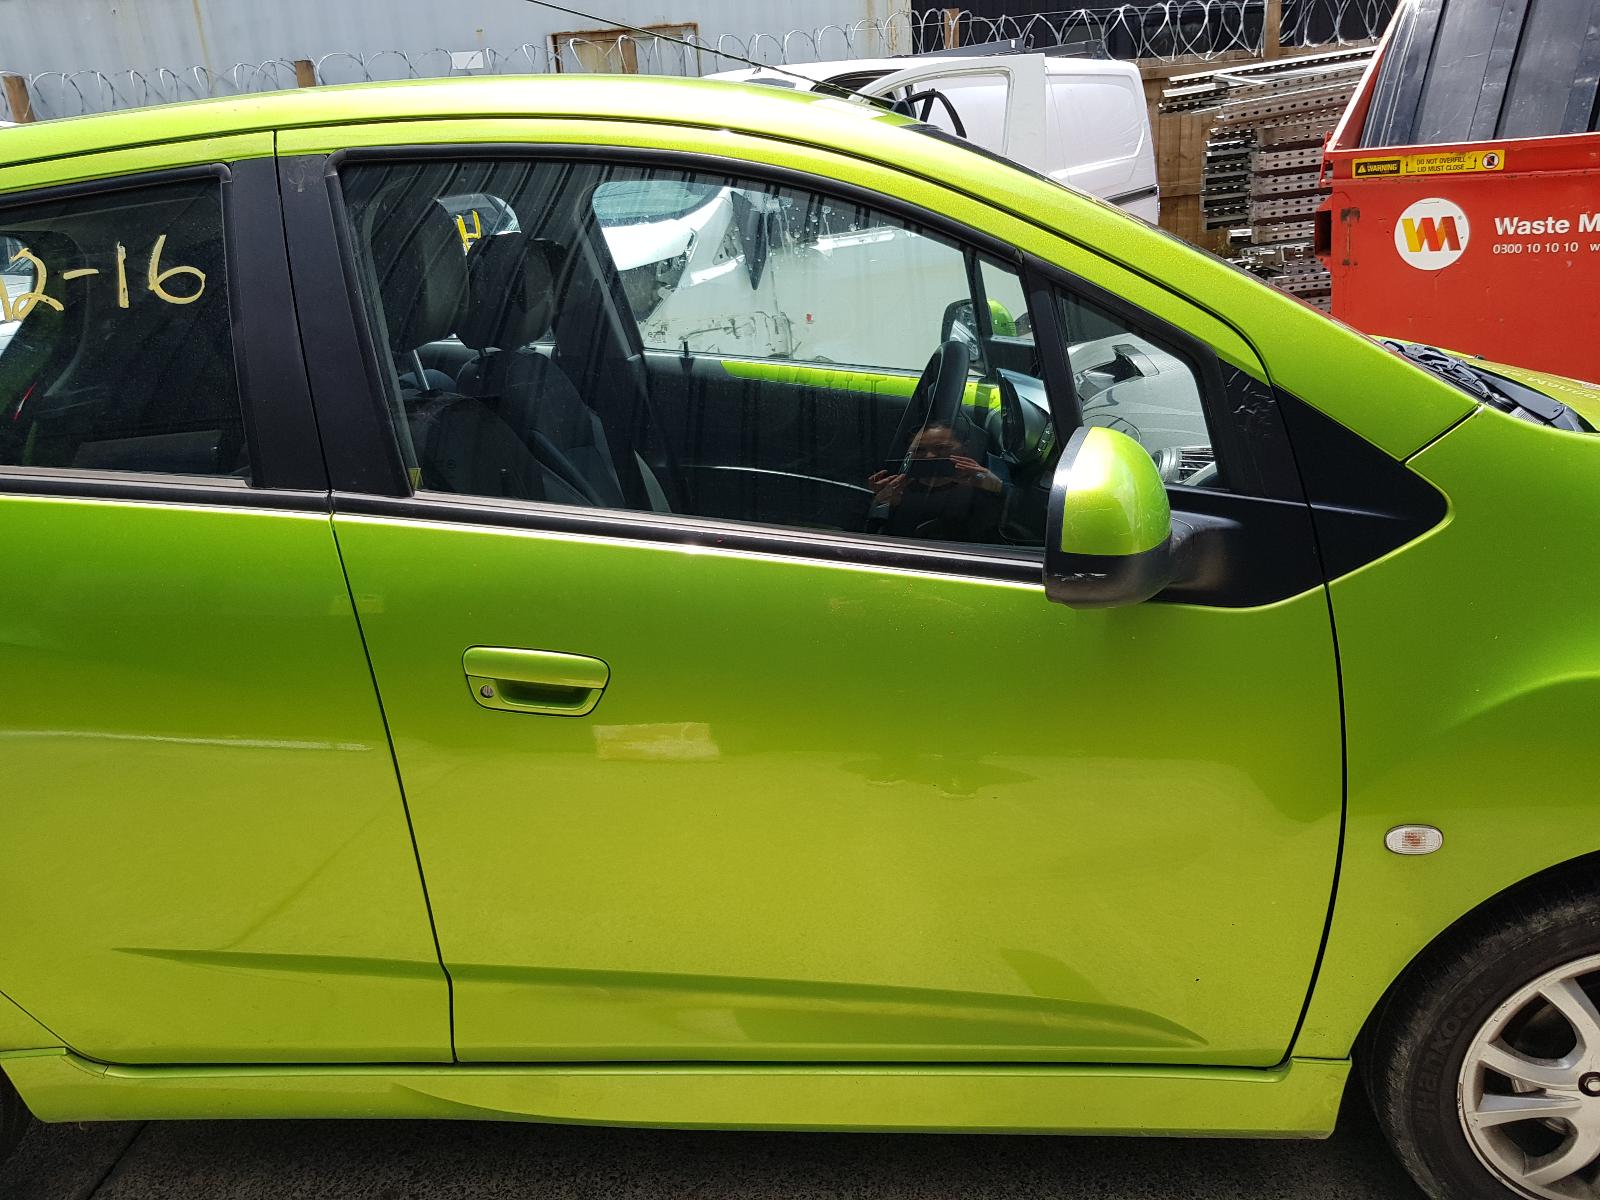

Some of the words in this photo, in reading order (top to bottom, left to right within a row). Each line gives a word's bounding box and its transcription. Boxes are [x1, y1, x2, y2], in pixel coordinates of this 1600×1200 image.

[1440, 156, 1466, 164] OVERFILL
[1366, 163, 1398, 173] WARNING
[1494, 216, 1570, 236] Waste
[1493, 243, 1522, 254] 0300
[1526, 243, 1541, 253] 10
[1545, 242, 1559, 253] 10
[1563, 241, 1579, 252] 10
